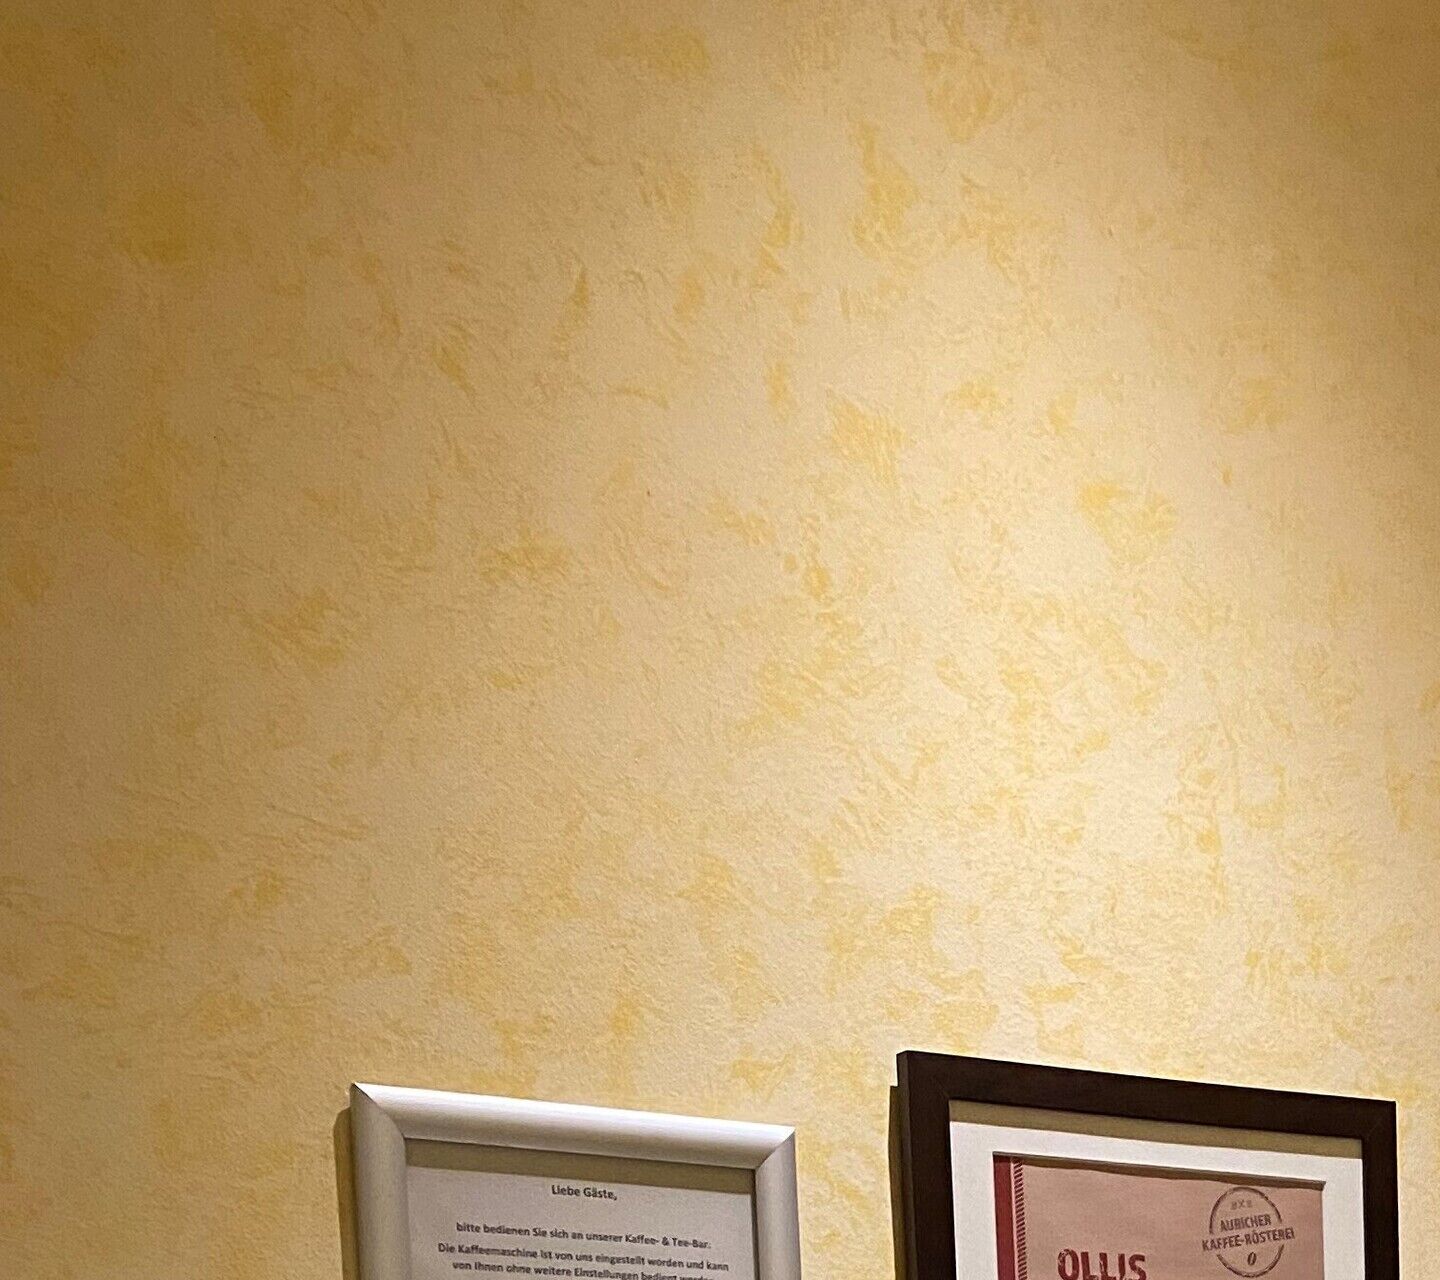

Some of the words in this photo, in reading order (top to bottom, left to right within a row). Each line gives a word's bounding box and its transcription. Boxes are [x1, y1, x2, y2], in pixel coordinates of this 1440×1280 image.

[551, 1185, 580, 1196] Liebe
[583, 1187, 617, 1201] Gäste,
[456, 1222, 480, 1233] bitte
[483, 1224, 530, 1236] bedienen
[533, 1228, 547, 1237] Sie
[550, 1228, 569, 1239] sich
[571, 1231, 583, 1239] an
[586, 1233, 622, 1242] unserer
[662, 1237, 670, 1246] &
[438, 1243, 455, 1253] Die
[458, 1245, 537, 1259] Kaffeemaschine
[540, 1250, 552, 1259] ist
[555, 1252, 573, 1261] von
[575, 1253, 593, 1262] uns
[595, 1253, 645, 1266] eingestellt
[647, 1258, 684, 1269] worden
[687, 1260, 704, 1269] und
[706, 1261, 729, 1271] kann
[453, 1262, 471, 1270] von
[474, 1261, 503, 1272] Ihnen
[506, 1264, 531, 1274] ohne
[534, 1266, 571, 1276] weitere
